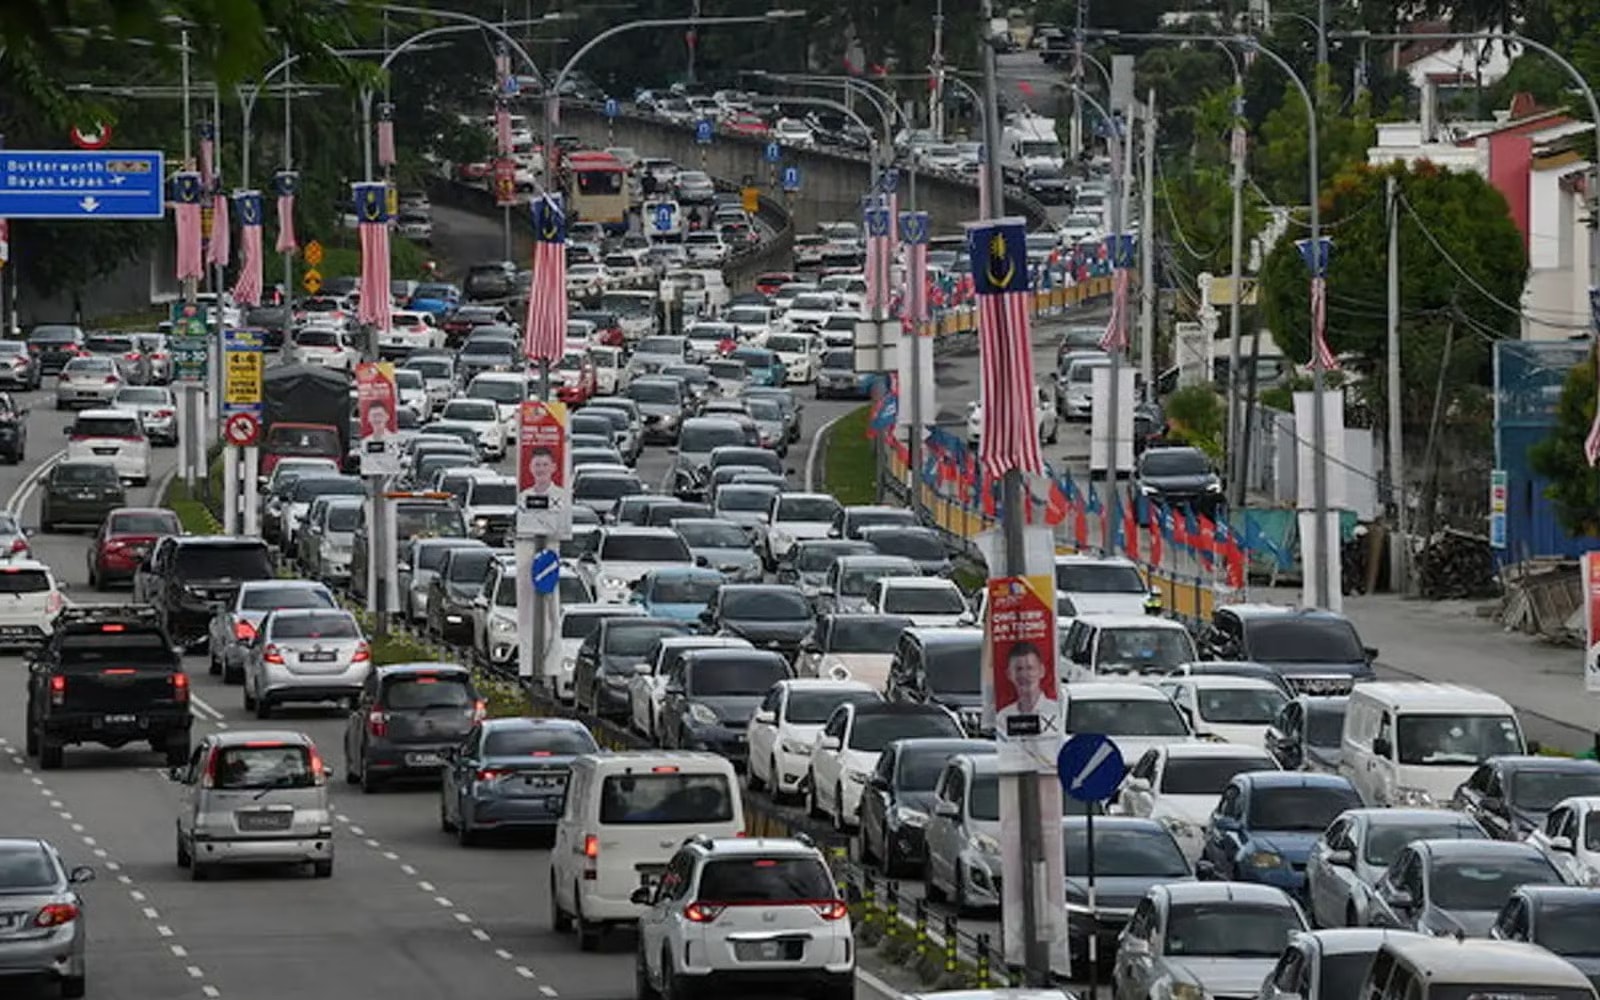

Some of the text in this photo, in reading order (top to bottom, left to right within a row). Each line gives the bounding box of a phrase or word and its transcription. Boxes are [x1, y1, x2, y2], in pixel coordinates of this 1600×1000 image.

[7, 159, 104, 172] Butterworth
[7, 175, 104, 188] Bayan Lepas
